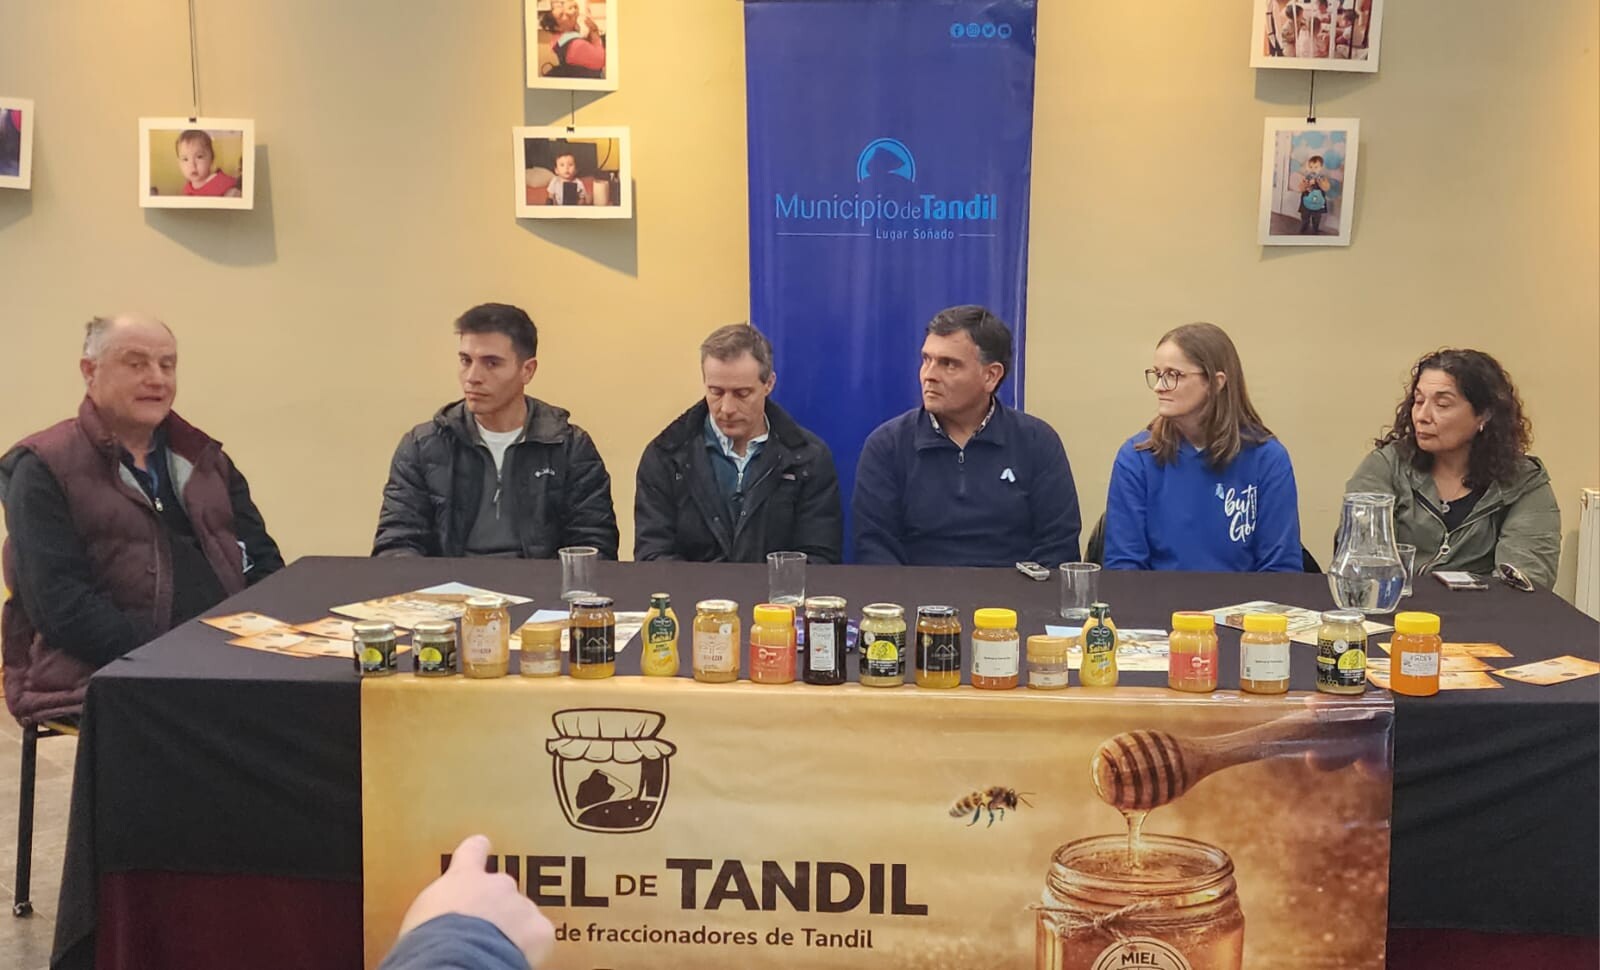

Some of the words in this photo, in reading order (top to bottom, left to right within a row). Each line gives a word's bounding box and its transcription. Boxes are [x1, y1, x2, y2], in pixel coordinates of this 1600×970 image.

[775, 193, 898, 227] Municipio
[900, 201, 921, 219] de
[920, 194, 997, 220] Tandil
[876, 228, 908, 241] Lugar
[913, 228, 955, 240] Soñado
[441, 854, 609, 908] IEL
[615, 875, 658, 897] DE
[666, 858, 929, 916] TANDIL
[554, 923, 582, 941] de
[587, 923, 758, 946] fraccionadores
[765, 928, 794, 946] de
[801, 928, 874, 949] Tandil
[1121, 951, 1159, 966] MIEL
